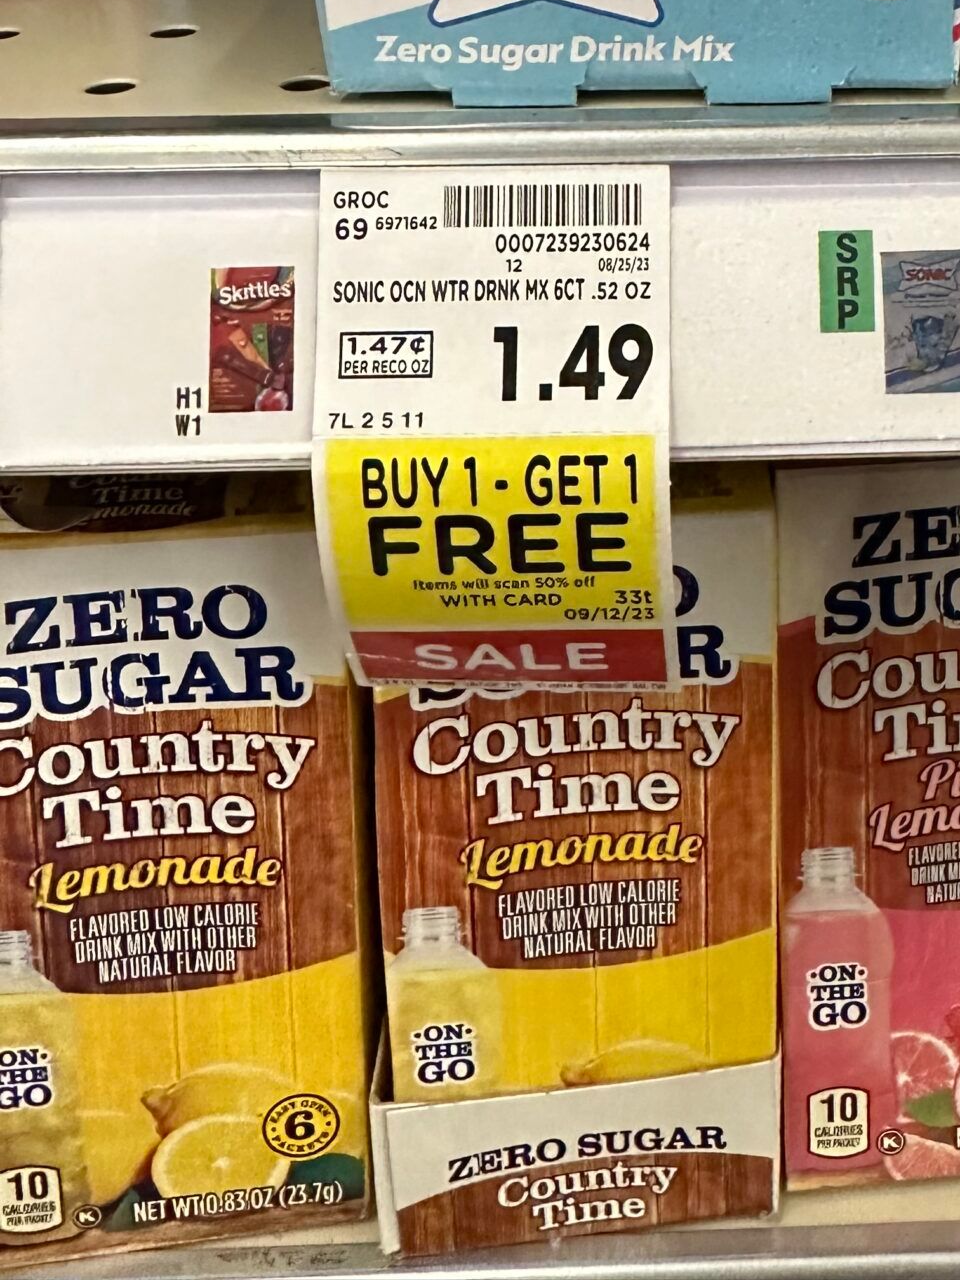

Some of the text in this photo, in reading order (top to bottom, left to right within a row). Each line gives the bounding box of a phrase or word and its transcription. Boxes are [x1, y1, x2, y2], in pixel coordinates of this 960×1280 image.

[374, 35, 736, 71] Zero Sugar Drink Mix
[333, 190, 389, 208] GROC
[335, 216, 437, 240] 69 6971642
[495, 232, 650, 253] 0007239230624
[506, 257, 650, 273] 12 08/25/23
[219, 281, 292, 305] Skittles
[333, 278, 651, 302] SONIC OCN WTR DRNK MX 6CT .52 OZ
[836, 232, 859, 330] SRP
[347, 336, 425, 356] 1.47¢
[344, 359, 429, 374] PER RECO OZ
[494, 323, 653, 401] 1.49
[362, 454, 637, 508] BUY 1 GET 1
[368, 512, 632, 576] FREE
[440, 593, 562, 607] WITH CARD
[614, 590, 653, 604] 33t
[4, 585, 267, 655] ZERO
[564, 607, 655, 621] 09/12/23
[414, 642, 609, 670] SALE
[413, 698, 740, 775] Country
[477, 763, 680, 825] Time
[43, 786, 255, 848] Time
[460, 823, 702, 890] Lemonade
[29, 848, 282, 913] Lemonade
[498, 879, 680, 918] FLAVORED LOW CALORIE
[813, 1001, 867, 1027] GO
[822, 1093, 858, 1122] 10
[449, 1126, 728, 1183] ZERO SUGAR
